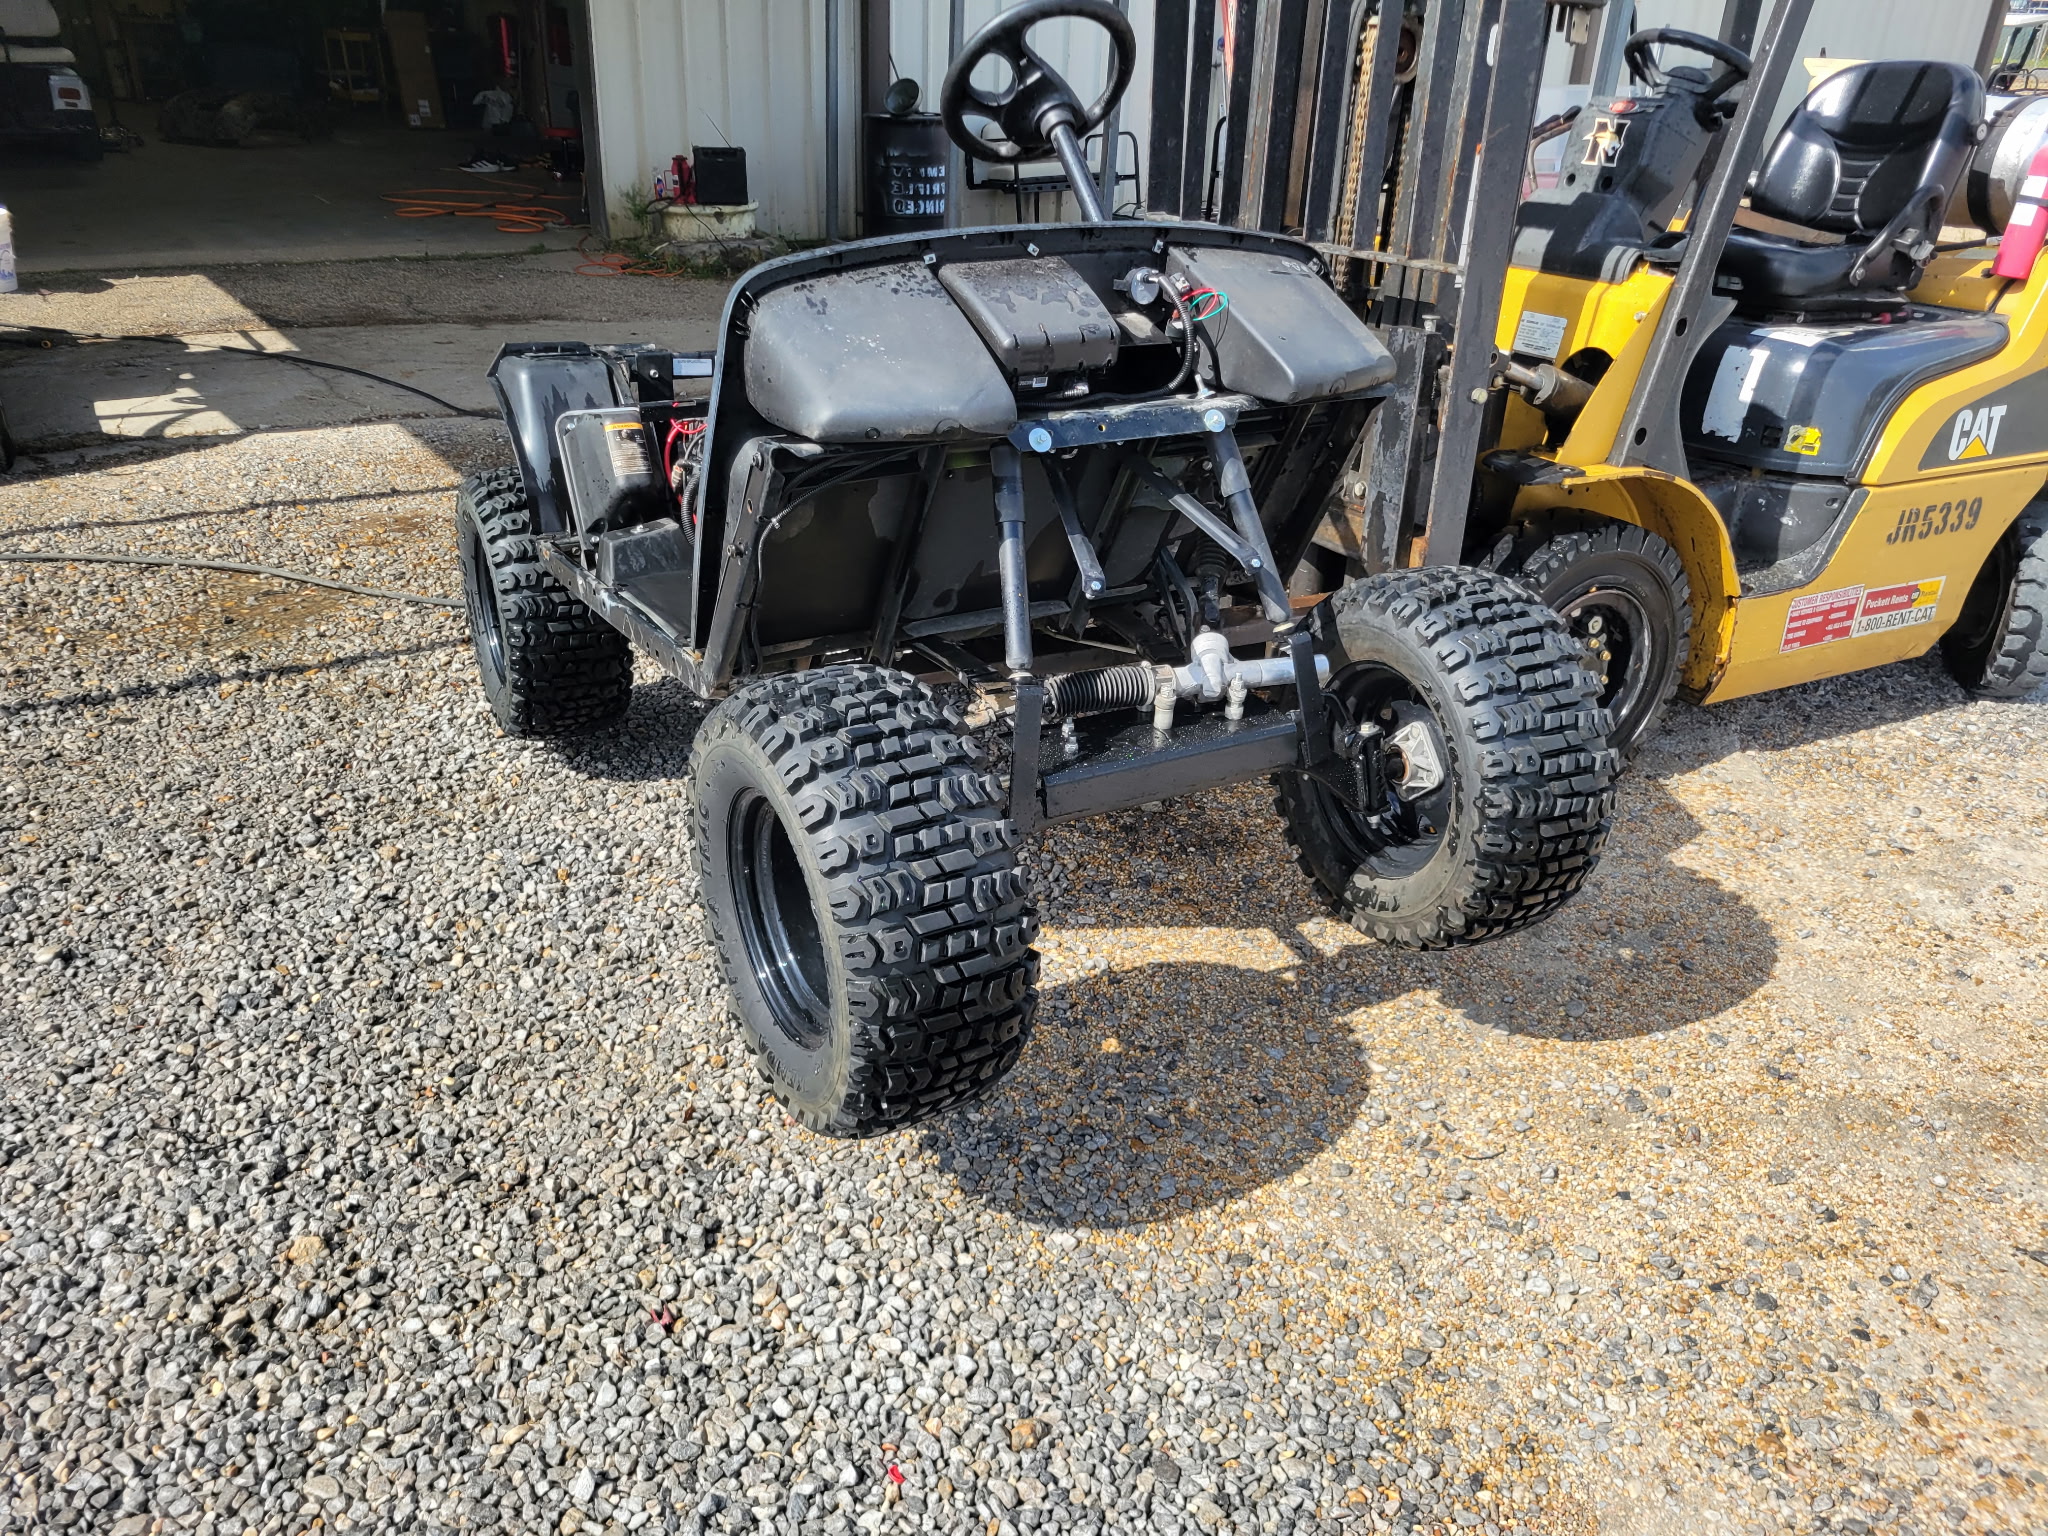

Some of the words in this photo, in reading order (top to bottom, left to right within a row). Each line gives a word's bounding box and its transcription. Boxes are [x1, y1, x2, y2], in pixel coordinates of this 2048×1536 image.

[1948, 405, 2008, 461] CAT
[1886, 497, 1983, 545] JR5339
[1856, 606, 1936, 634] 1-800-RENT-CAT
